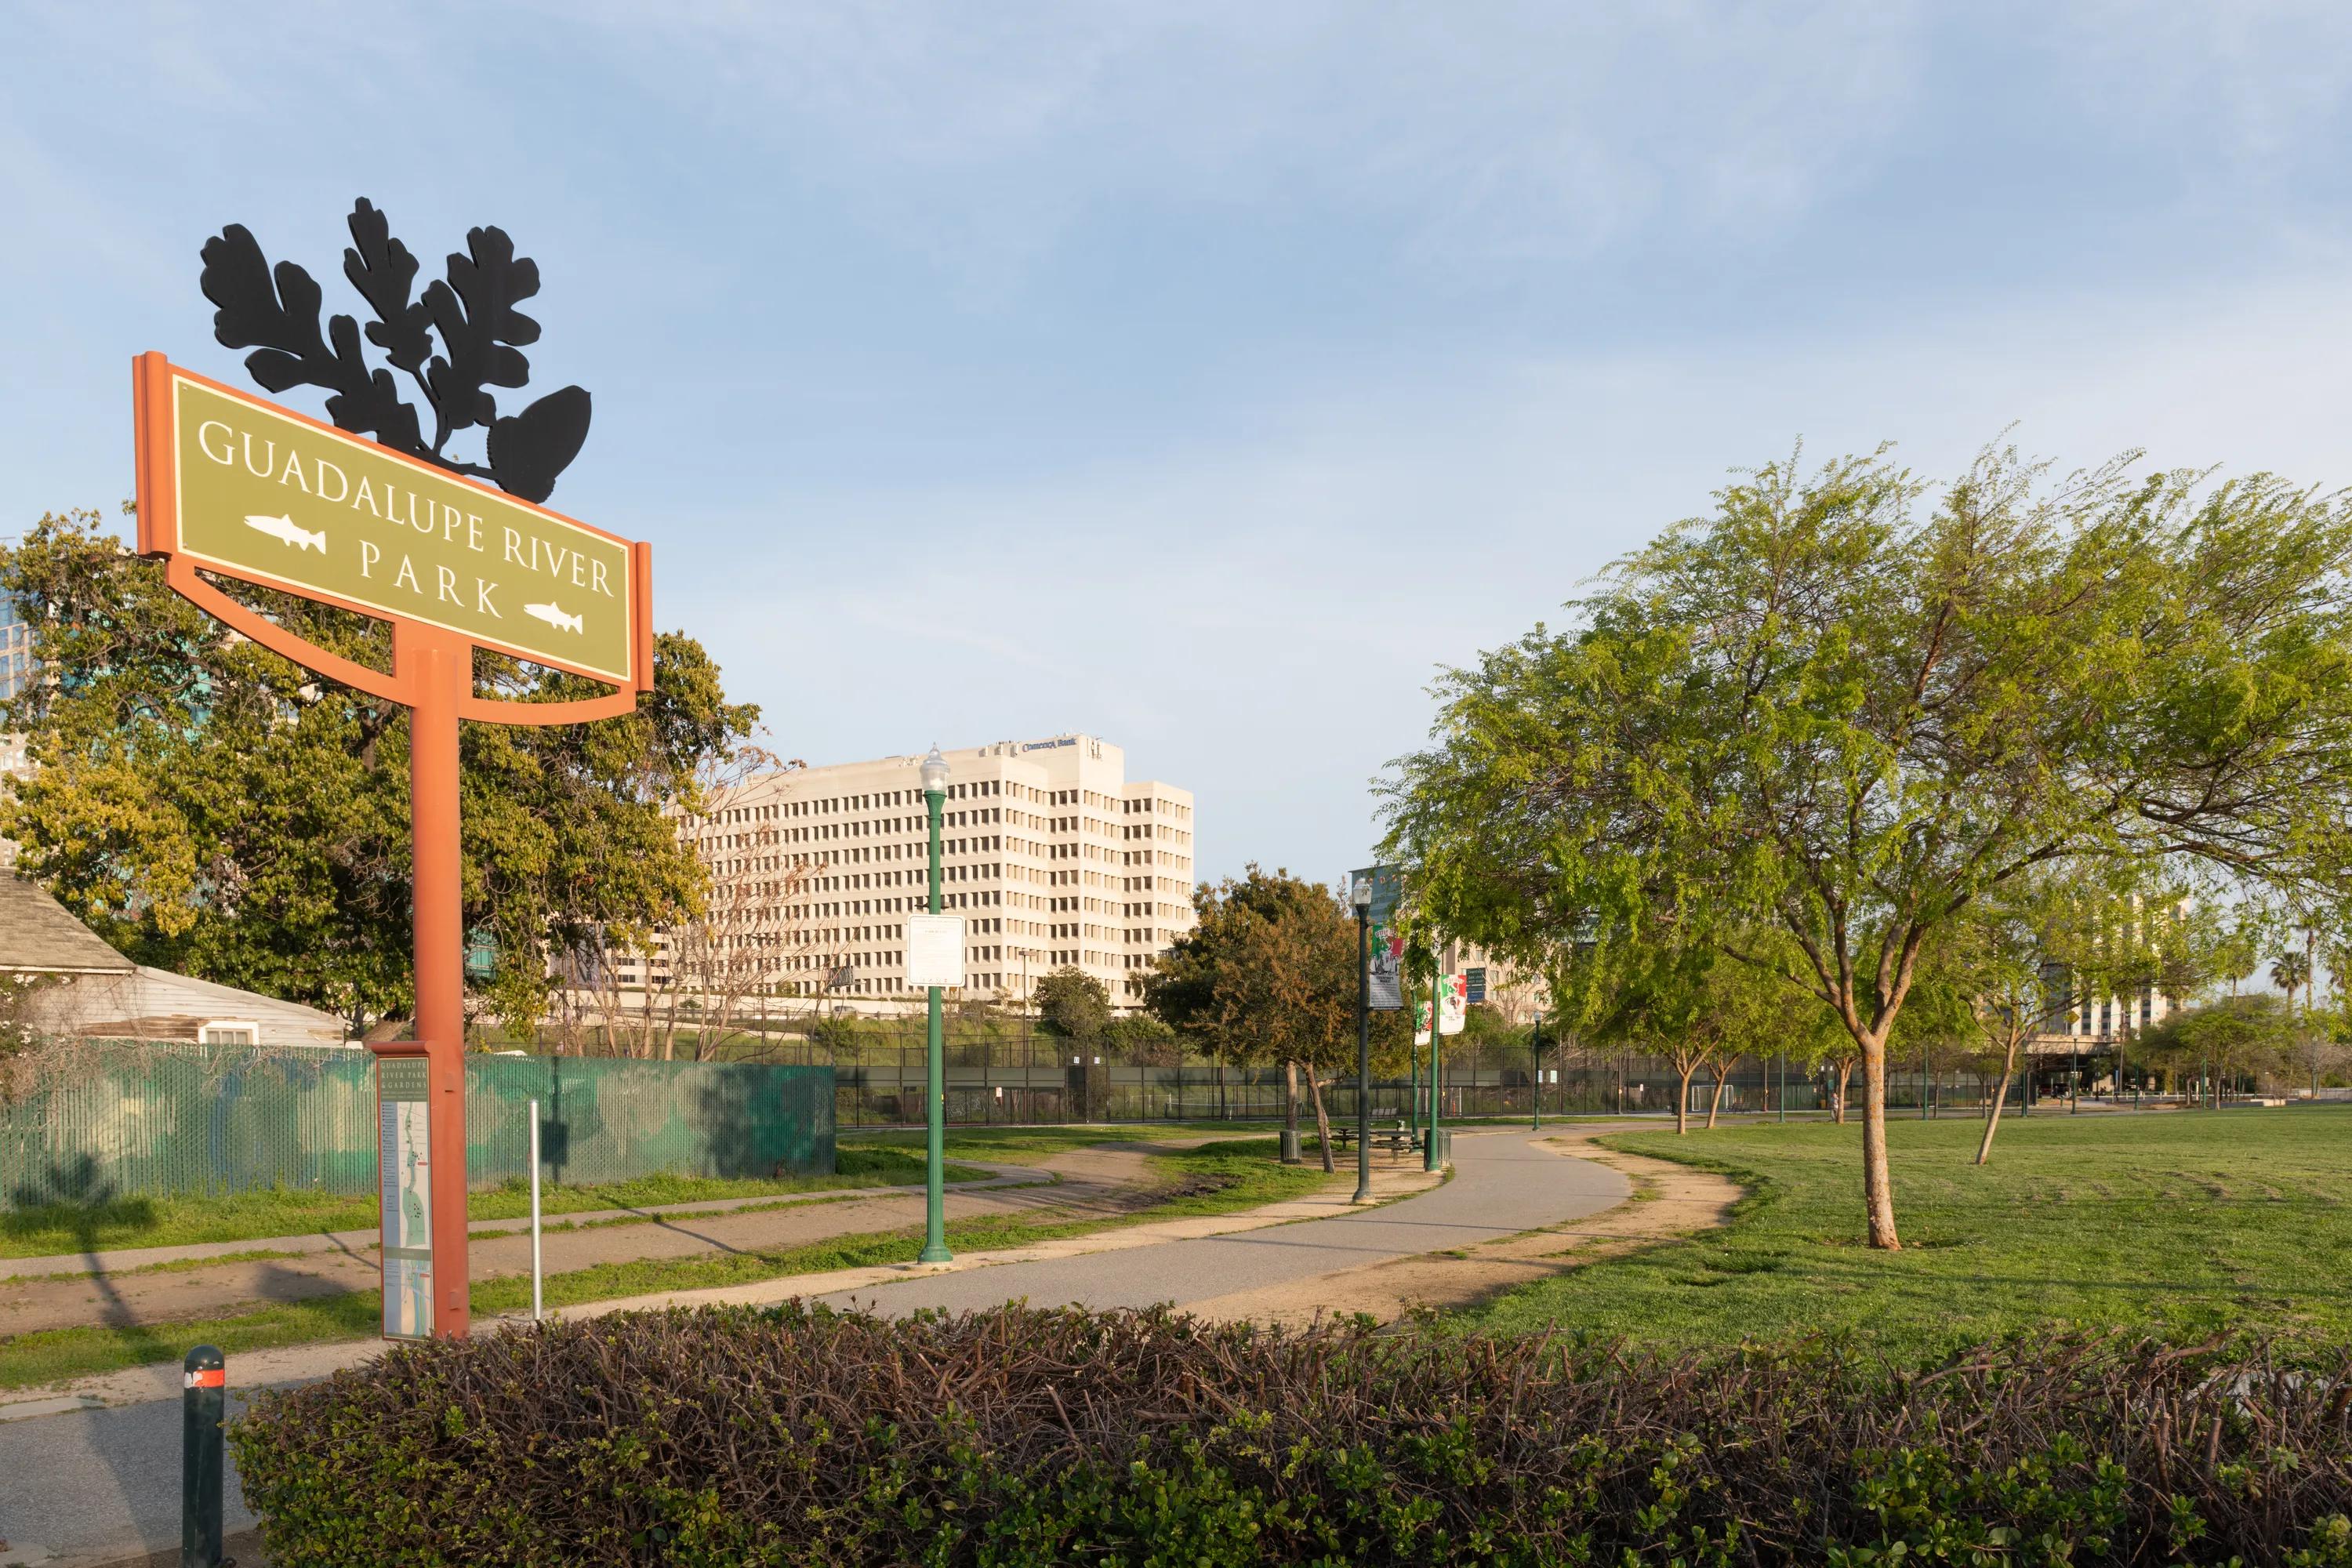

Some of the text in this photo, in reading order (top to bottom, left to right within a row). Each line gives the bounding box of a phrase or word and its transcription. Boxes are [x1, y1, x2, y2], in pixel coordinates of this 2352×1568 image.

[198, 420, 615, 597] GUADALUPE RIVER
[359, 539, 503, 619] PARK
[1057, 738, 1076, 746] Bank
